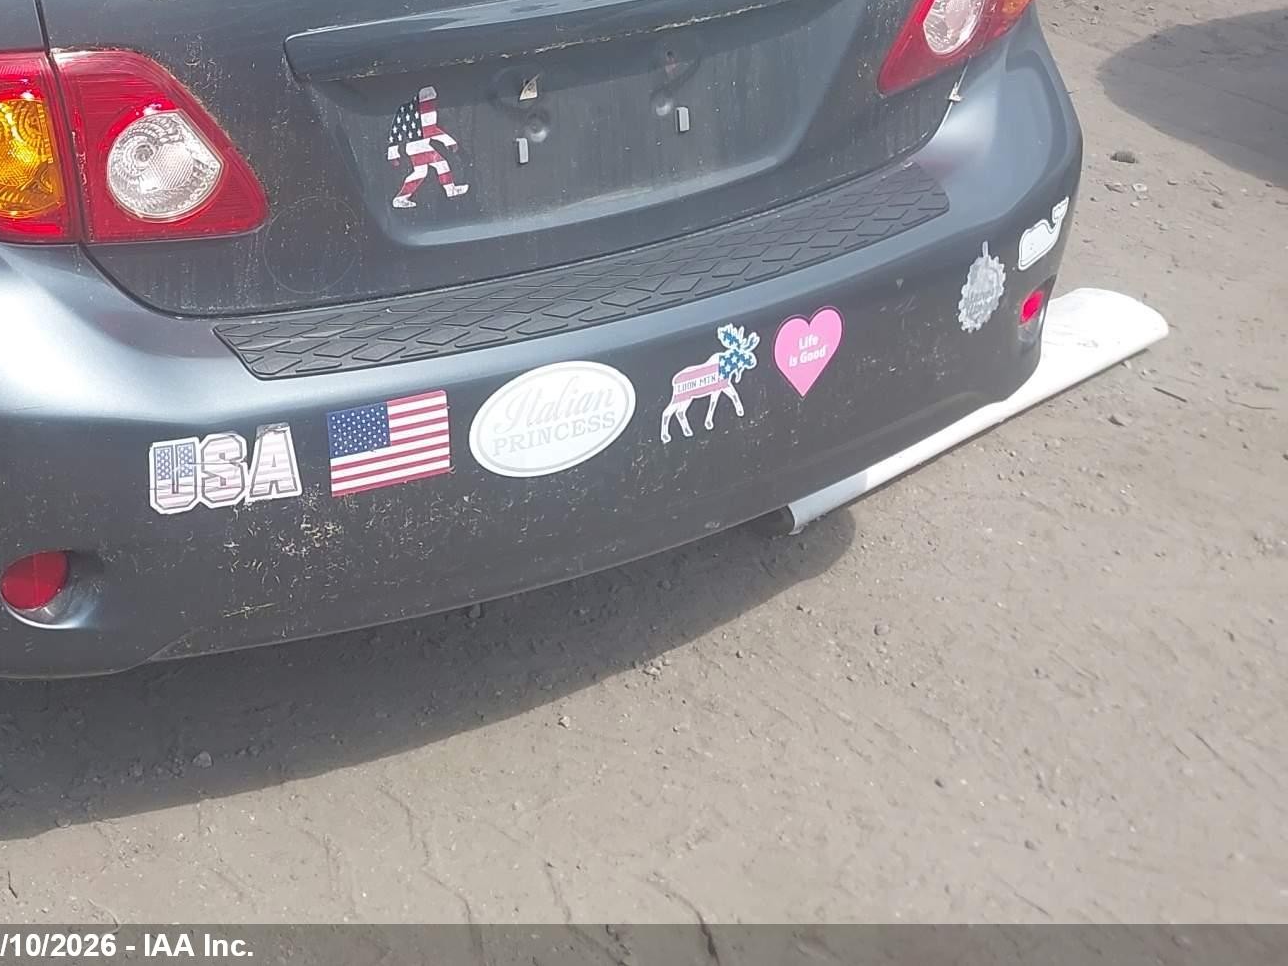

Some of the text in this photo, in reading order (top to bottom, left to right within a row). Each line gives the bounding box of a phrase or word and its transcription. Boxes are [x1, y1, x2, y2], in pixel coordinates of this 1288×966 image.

[798, 334, 819, 350] Life
[799, 345, 826, 364] Good
[494, 375, 615, 434] Italian
[492, 411, 616, 457] PRINCESS
[149, 423, 302, 515] USA
